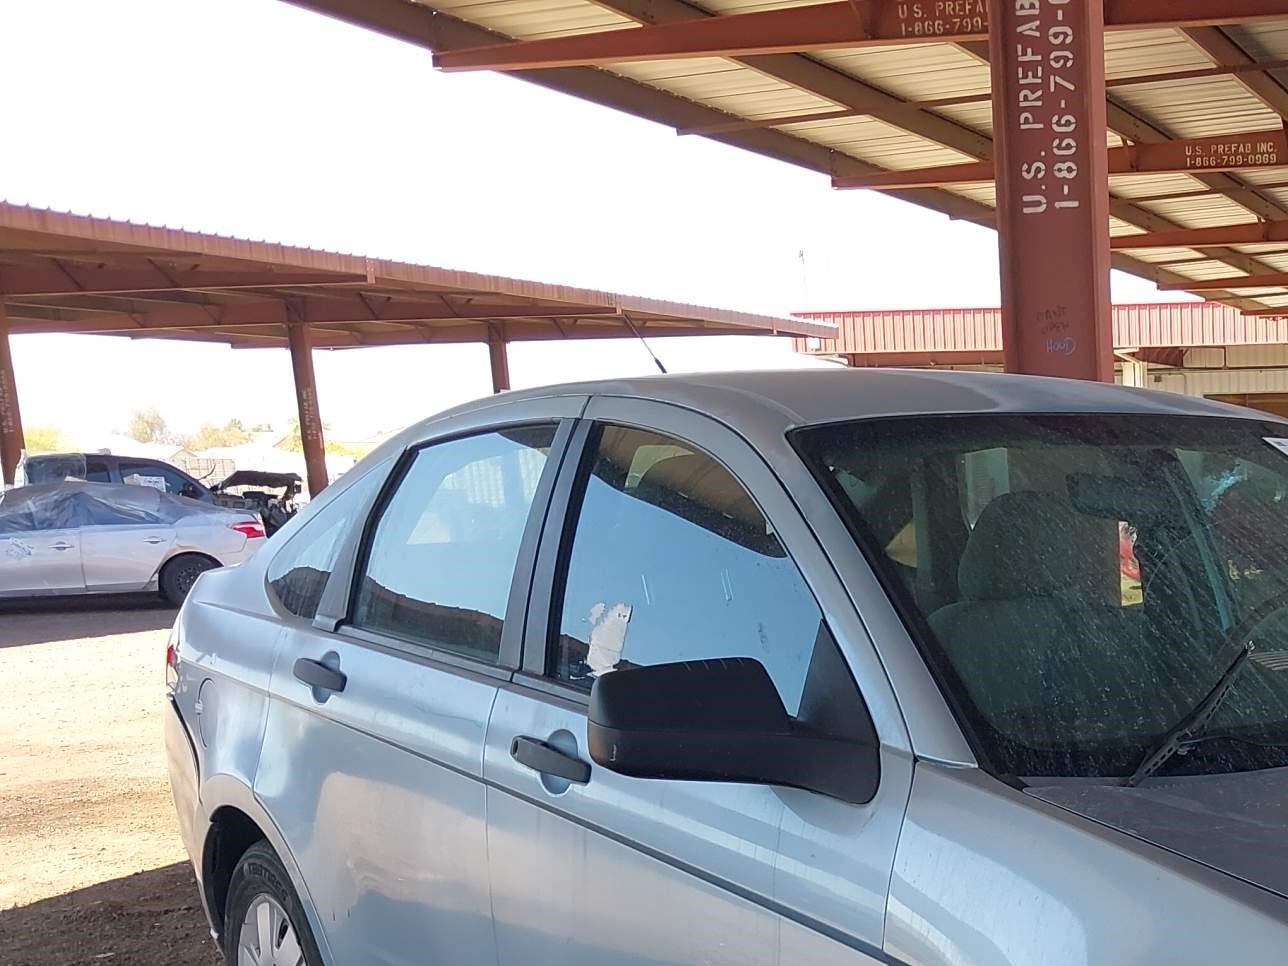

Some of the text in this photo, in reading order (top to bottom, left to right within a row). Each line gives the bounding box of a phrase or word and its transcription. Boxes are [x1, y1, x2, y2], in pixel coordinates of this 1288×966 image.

[935, 0, 989, 17] PREFA
[1015, 0, 1047, 213] U.S. PREFAB
[1047, 0, 1079, 208] 1-866-799-
[1184, 142, 1278, 156] U.S. PREFAB INC.
[1186, 153, 1277, 168] 1-866-799-0969
